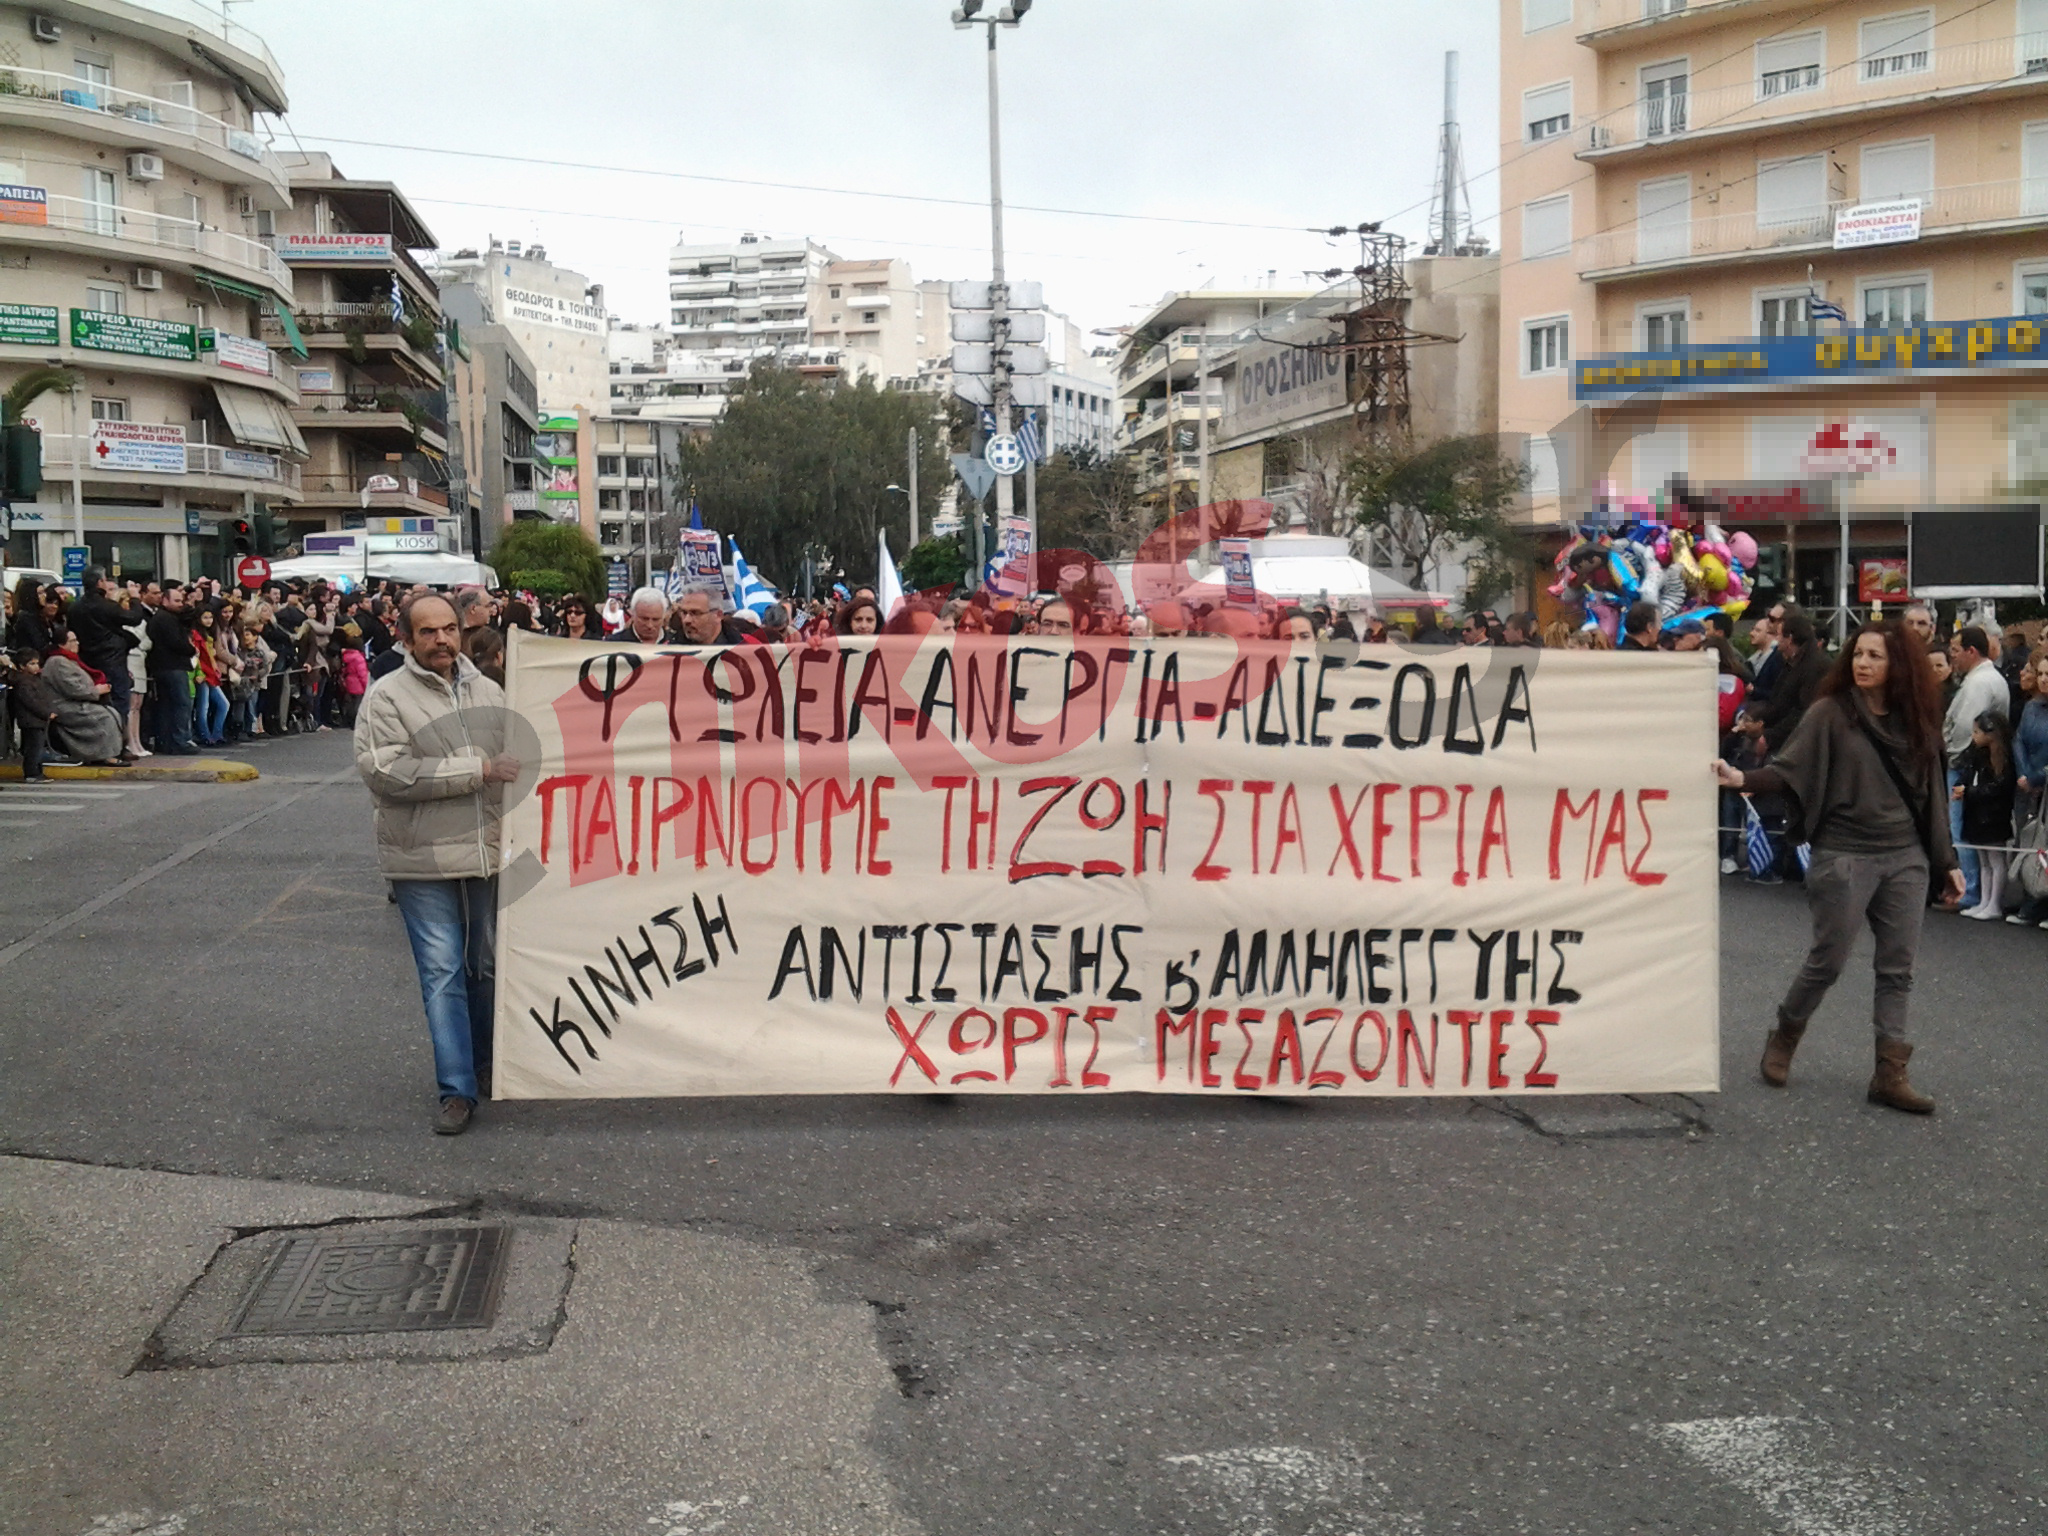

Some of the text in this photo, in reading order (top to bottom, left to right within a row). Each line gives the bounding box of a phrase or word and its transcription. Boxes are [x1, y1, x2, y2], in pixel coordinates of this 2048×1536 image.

[289, 235, 385, 245] ΠΑΙΔΙΑΤΡΟΣ
[1838, 213, 1917, 230] ΕΝΟΙΚΙΑΖΕΤΑΙ
[80, 311, 190, 335] ΙΑΤΡΕΙΟ ΥΠΕΡΗΧΩΝ
[506, 288, 554, 309] ΘΕΟΔΩΡΟΣ
[569, 301, 603, 320] ΤΟΥΝΤΑΣ
[1242, 332, 1341, 405] ΟΡΟΣΗΜΟ
[395, 536, 435, 548] KIOSK
[534, 774, 896, 876] ΠΑΙΡΝΟΥΜΕ
[931, 776, 1000, 874] ΤΗ
[1192, 778, 1307, 882] ΣΤΑ
[1327, 781, 1513, 887] ΧΕΡΙΑ
[1548, 787, 1669, 887] ΜΑΣ
[529, 891, 738, 1075] ΚΙΝΗΣΗ
[767, 922, 1143, 1005] ΑΝΤΙΣΤΑΣΗΣ
[1208, 927, 1585, 1005] ΑΛΛΗΛΕΓΓΥΗΣ
[885, 1005, 1562, 1090] ΧΩΡΙΣ ΜΕΣΑΖΟΝΤΕΣ
